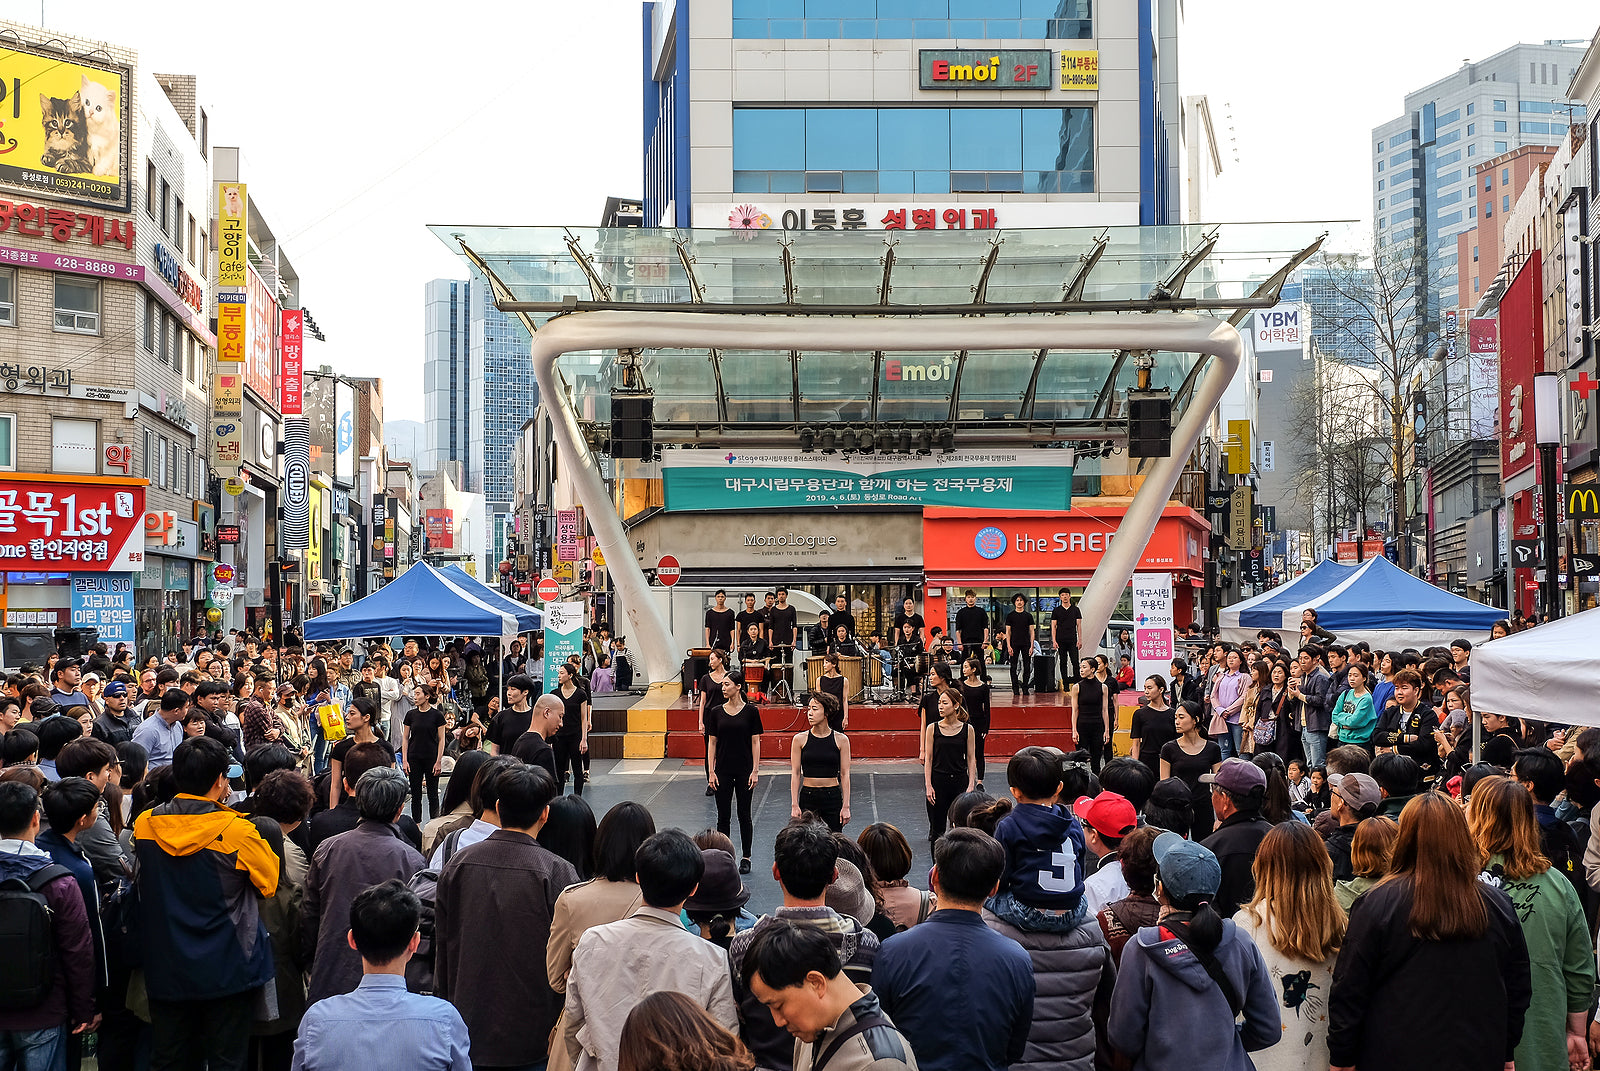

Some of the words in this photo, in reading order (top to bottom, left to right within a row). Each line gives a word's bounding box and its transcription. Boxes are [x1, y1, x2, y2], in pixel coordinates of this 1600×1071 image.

[1014, 64, 1038, 82] 2F
[1061, 74, 1098, 85] 010-8905-8084
[21, 171, 49, 184] 동성로점
[55, 178, 112, 195] 053)241-0203
[222, 219, 243, 261] 고양이
[54, 256, 116, 275] 428-8889
[125, 266, 139, 277] 3F
[1259, 310, 1298, 328] YBM
[222, 306, 243, 358] 부동산
[1259, 327, 1299, 343] 어학원
[284, 345, 300, 392] 방탈출
[286, 394, 298, 403] 3F
[216, 441, 240, 454] 노래
[106, 446, 132, 474] 약
[218, 453, 239, 461] 연습장
[289, 465, 305, 503] FOLDER
[724, 477, 855, 492] 대구시립무용단과
[858, 478, 891, 492] 함께
[895, 478, 928, 492] 하는
[932, 477, 1013, 493] 전국무용제
[864, 493, 887, 501] 동성로
[145, 512, 173, 545] 약
[743, 532, 838, 549] Monologue
[1016, 533, 1047, 552] the
[27, 538, 108, 562] 할인직영점
[128, 551, 143, 562] 본점
[216, 569, 233, 579] 노래
[75, 578, 108, 592] 갤럭시
[112, 579, 131, 592] S10
[81, 594, 124, 608] 지금까지
[1135, 588, 1170, 599] 대구시립
[1140, 599, 1166, 610] 무용단
[74, 610, 97, 623] 이런
[100, 610, 132, 623] 할인은
[1149, 615, 1171, 625] stage
[1147, 631, 1161, 640] 시립
[1142, 640, 1168, 648] 무용단과
[1038, 837, 1078, 892] 3
